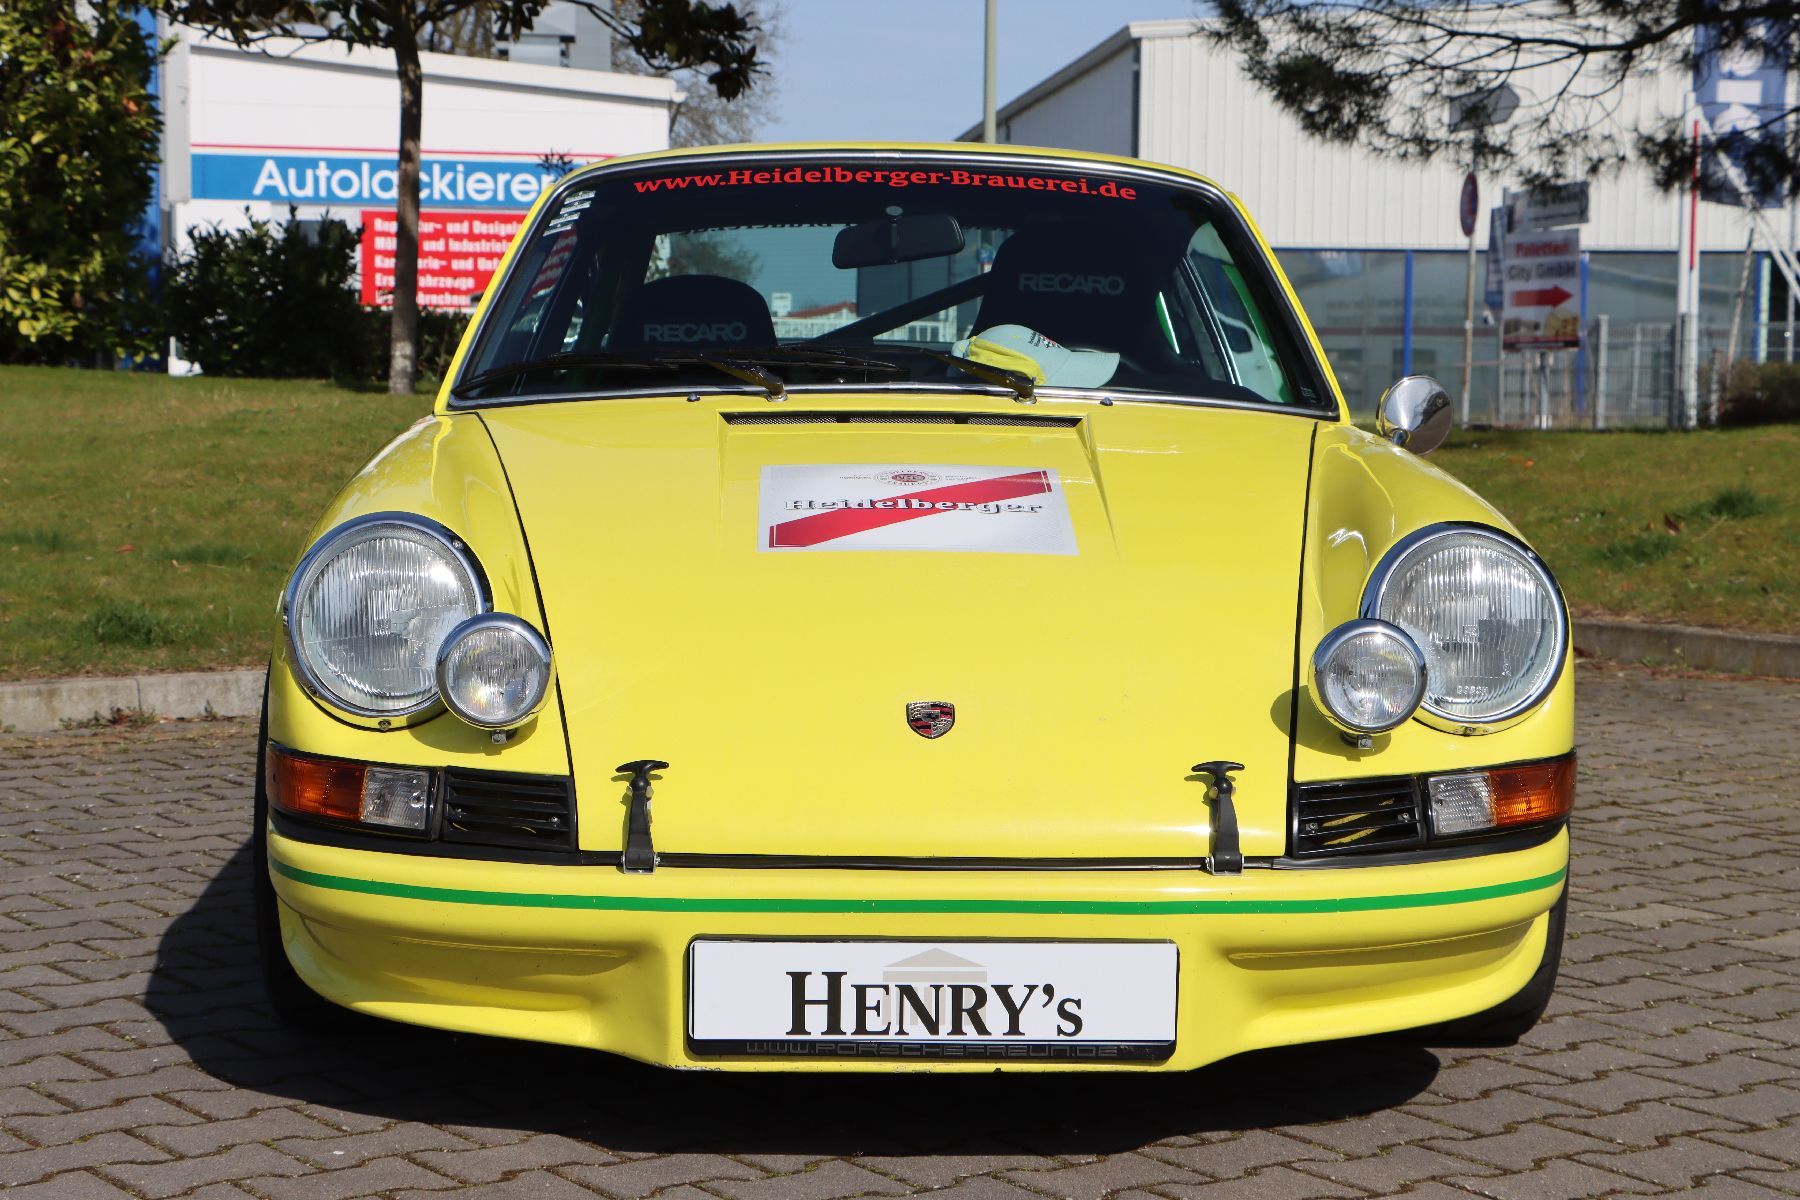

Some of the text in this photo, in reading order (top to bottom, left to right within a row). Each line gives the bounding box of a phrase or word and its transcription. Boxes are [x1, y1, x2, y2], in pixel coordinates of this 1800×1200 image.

[634, 167, 1137, 200] www.Heidelberger-Brauerei.de
[446, 220, 469, 233] und
[423, 238, 445, 251] und
[451, 257, 474, 270] und
[1019, 273, 1125, 294] RECARO
[643, 322, 747, 342] RECARO
[784, 498, 1045, 515] Heidelberger
